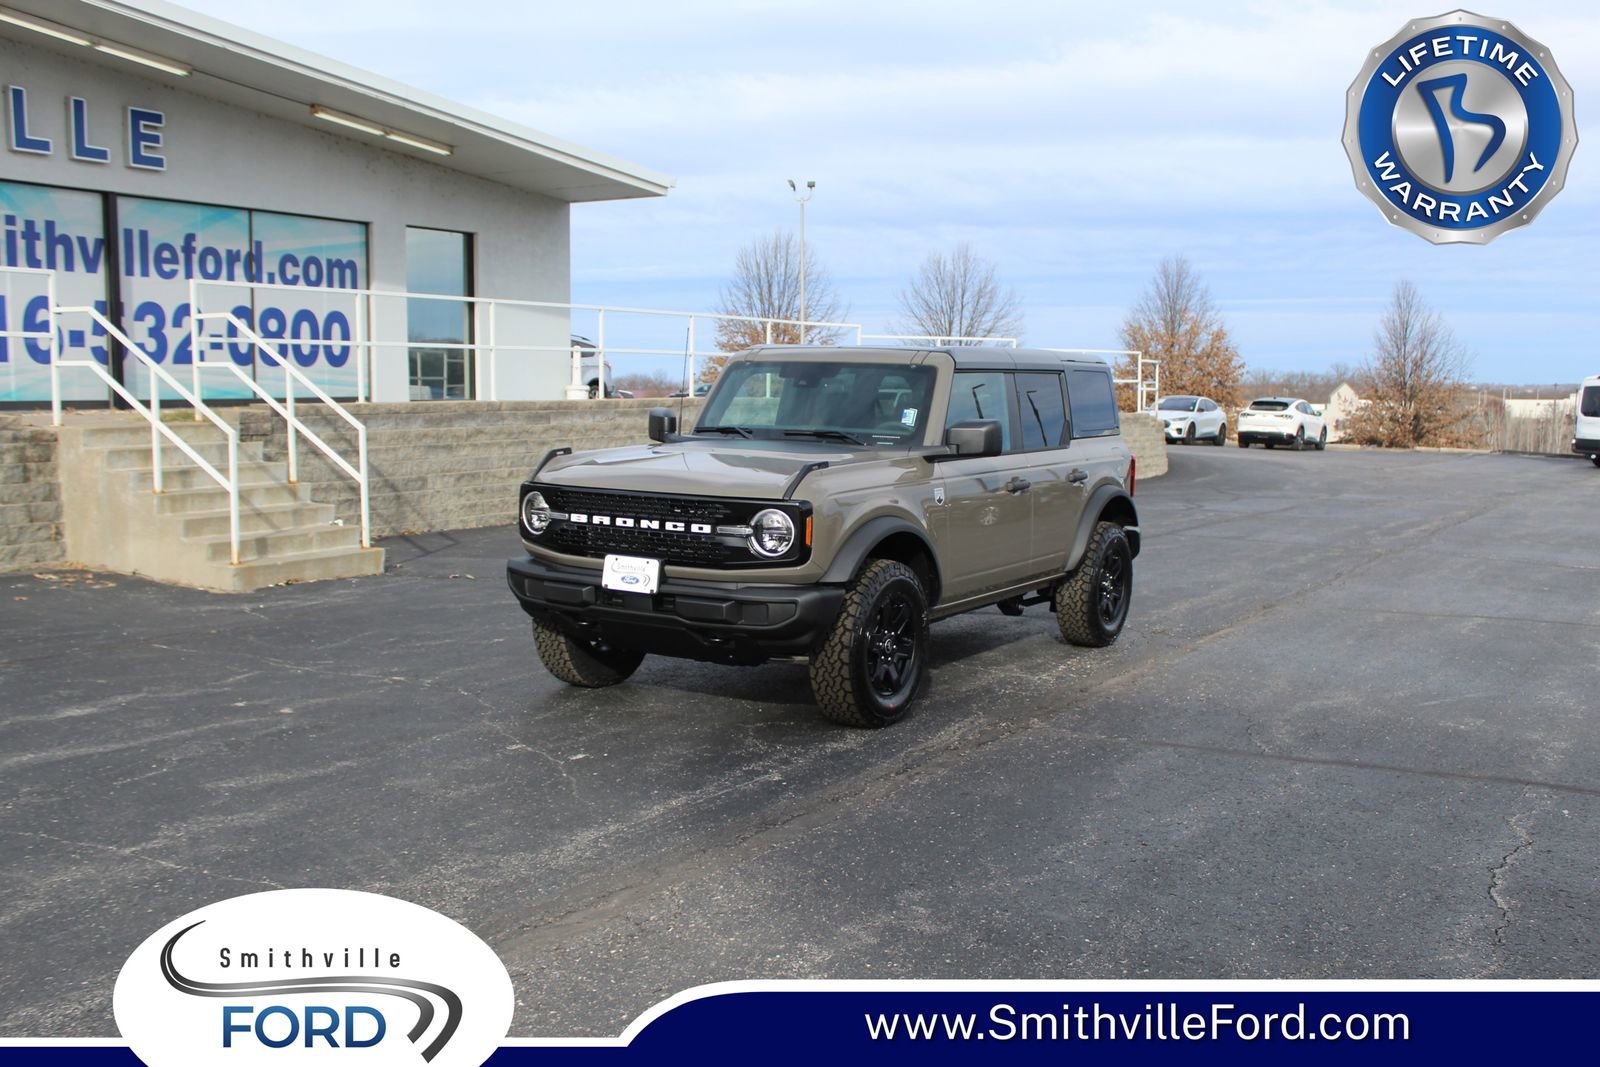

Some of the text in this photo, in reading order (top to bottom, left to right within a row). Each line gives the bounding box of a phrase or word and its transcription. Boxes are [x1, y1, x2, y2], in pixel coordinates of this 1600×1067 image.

[8, 85, 167, 171] LLE
[4, 214, 359, 289] ithvlleford.com
[570, 513, 712, 534] BRONCO
